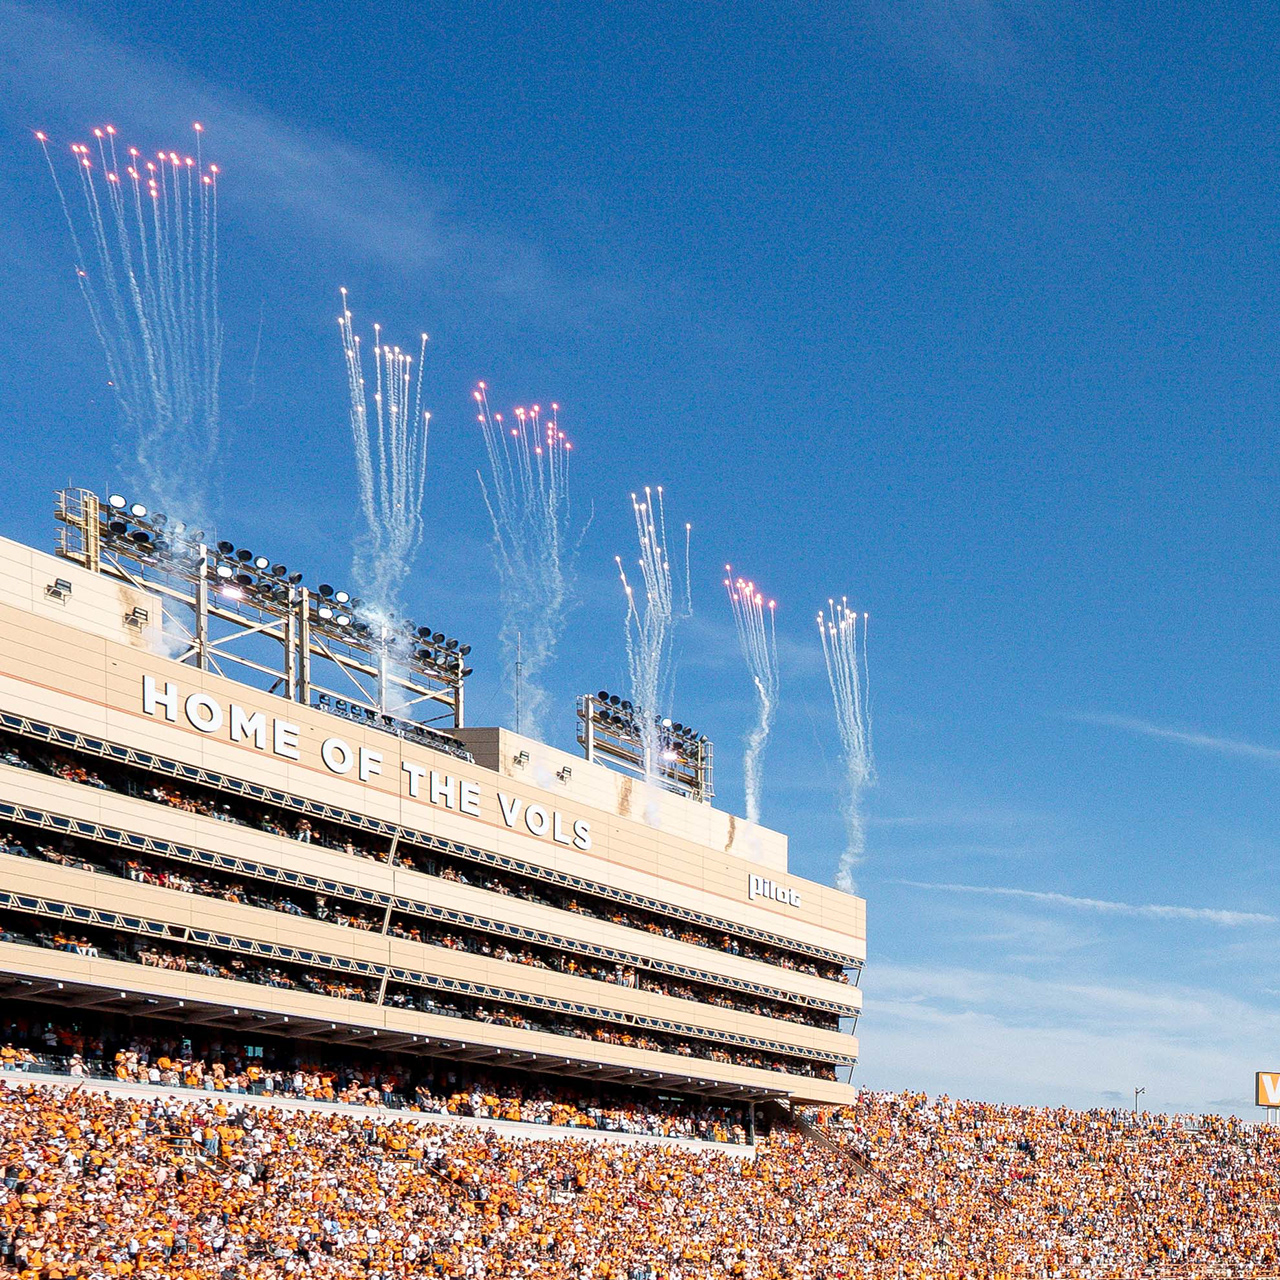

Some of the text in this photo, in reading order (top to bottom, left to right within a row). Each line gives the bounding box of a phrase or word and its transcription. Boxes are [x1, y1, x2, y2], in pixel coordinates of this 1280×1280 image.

[143, 675, 592, 852] HOME OF THE VOLS
